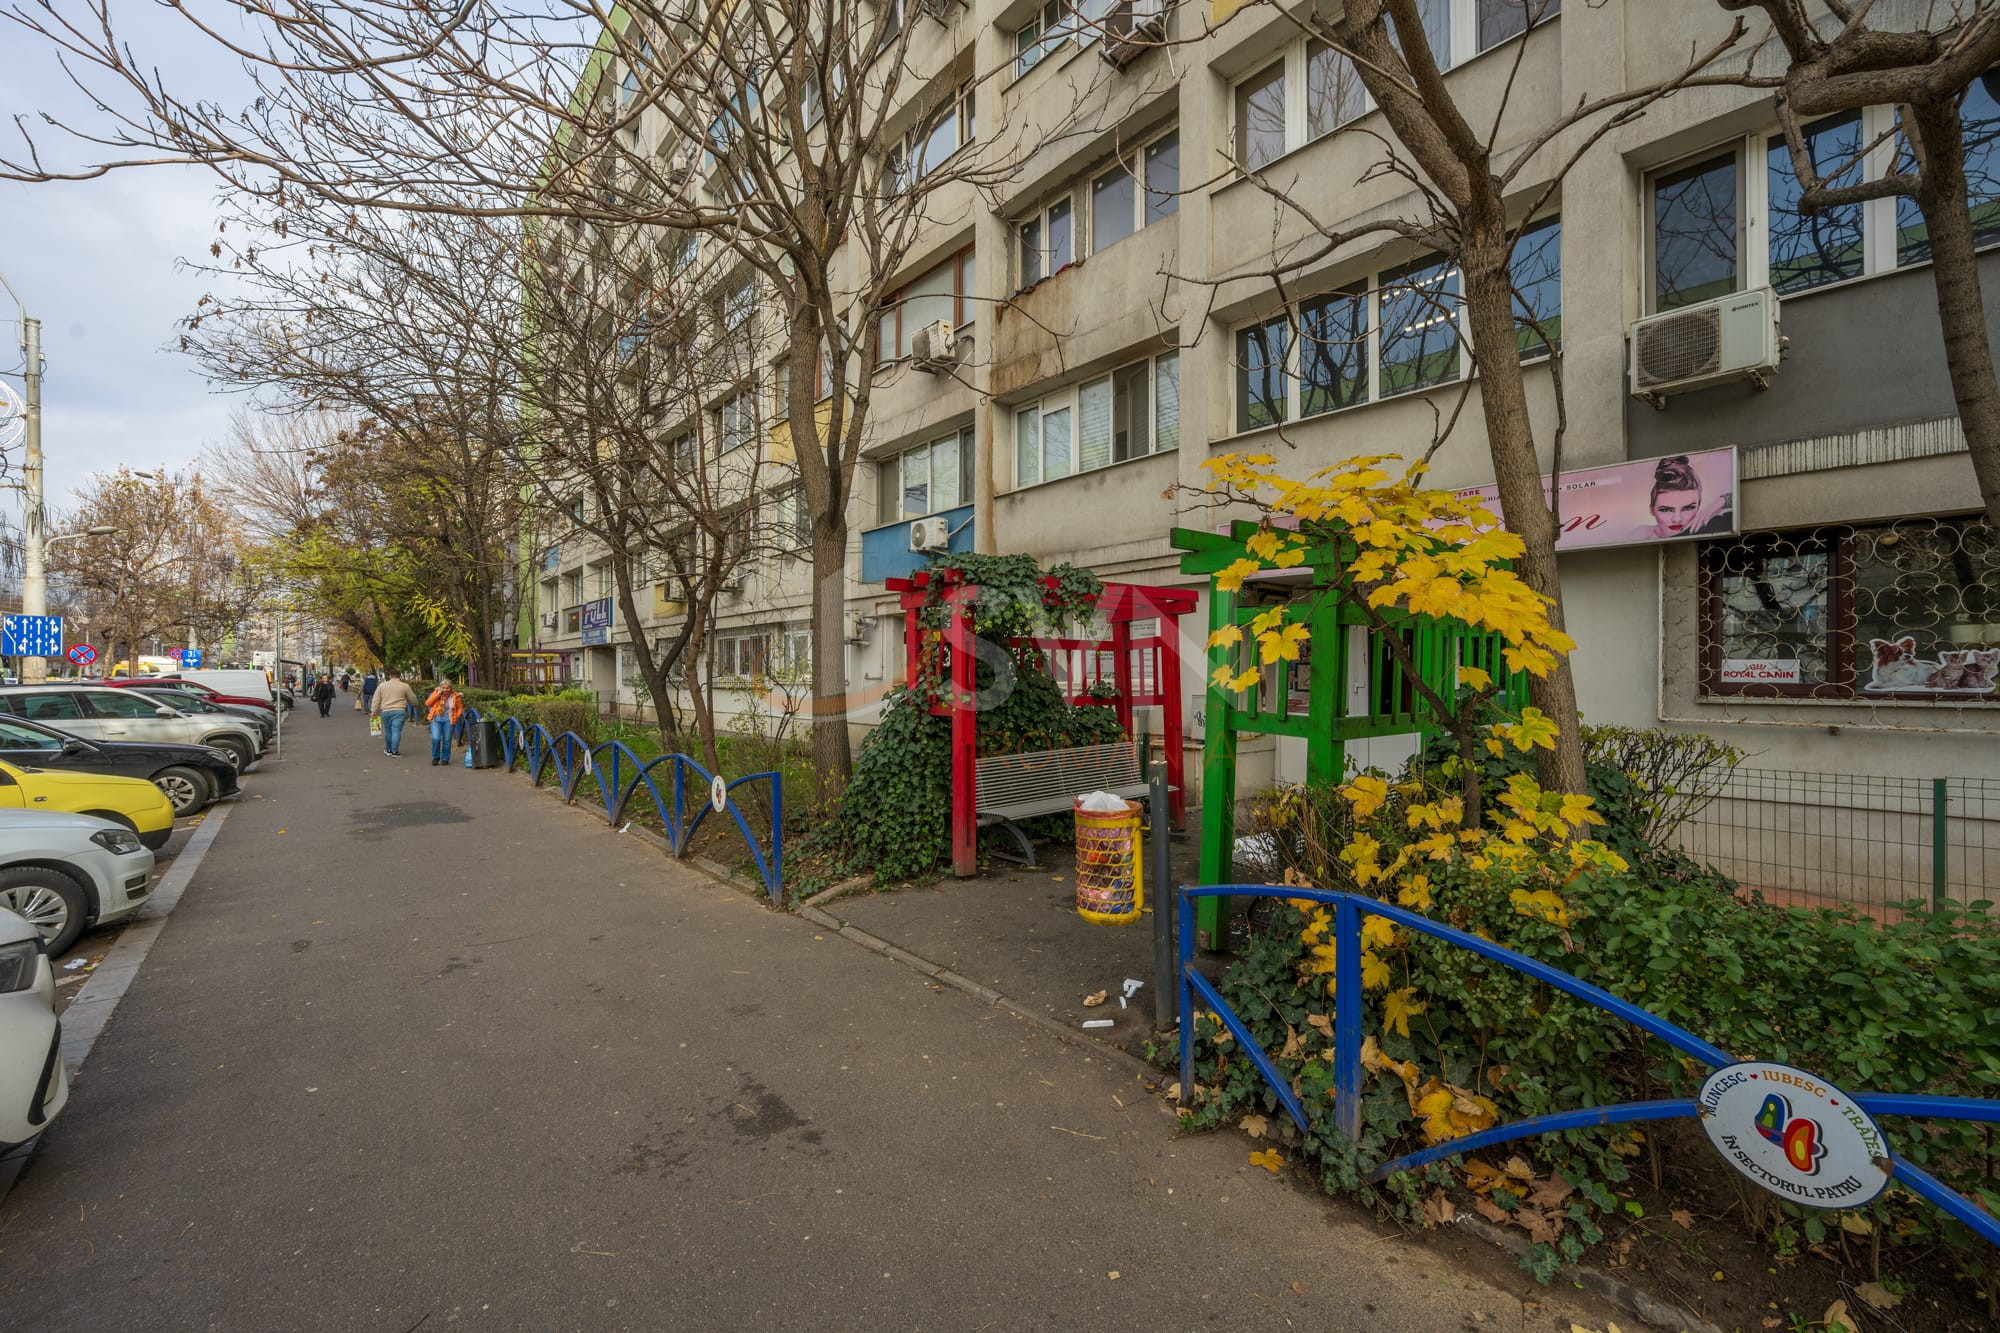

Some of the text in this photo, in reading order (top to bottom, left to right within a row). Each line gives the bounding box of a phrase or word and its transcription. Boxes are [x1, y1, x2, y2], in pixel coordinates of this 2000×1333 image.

[1566, 481, 1596, 490] SOLAR
[1455, 489, 1481, 499] TARE
[1758, 671, 1794, 679] CANIN
[1705, 1070, 1883, 1161] MUNCESC IUBESC TRĂIES
[1721, 1135, 1862, 1199] ÎN SECTORUL PATRU
